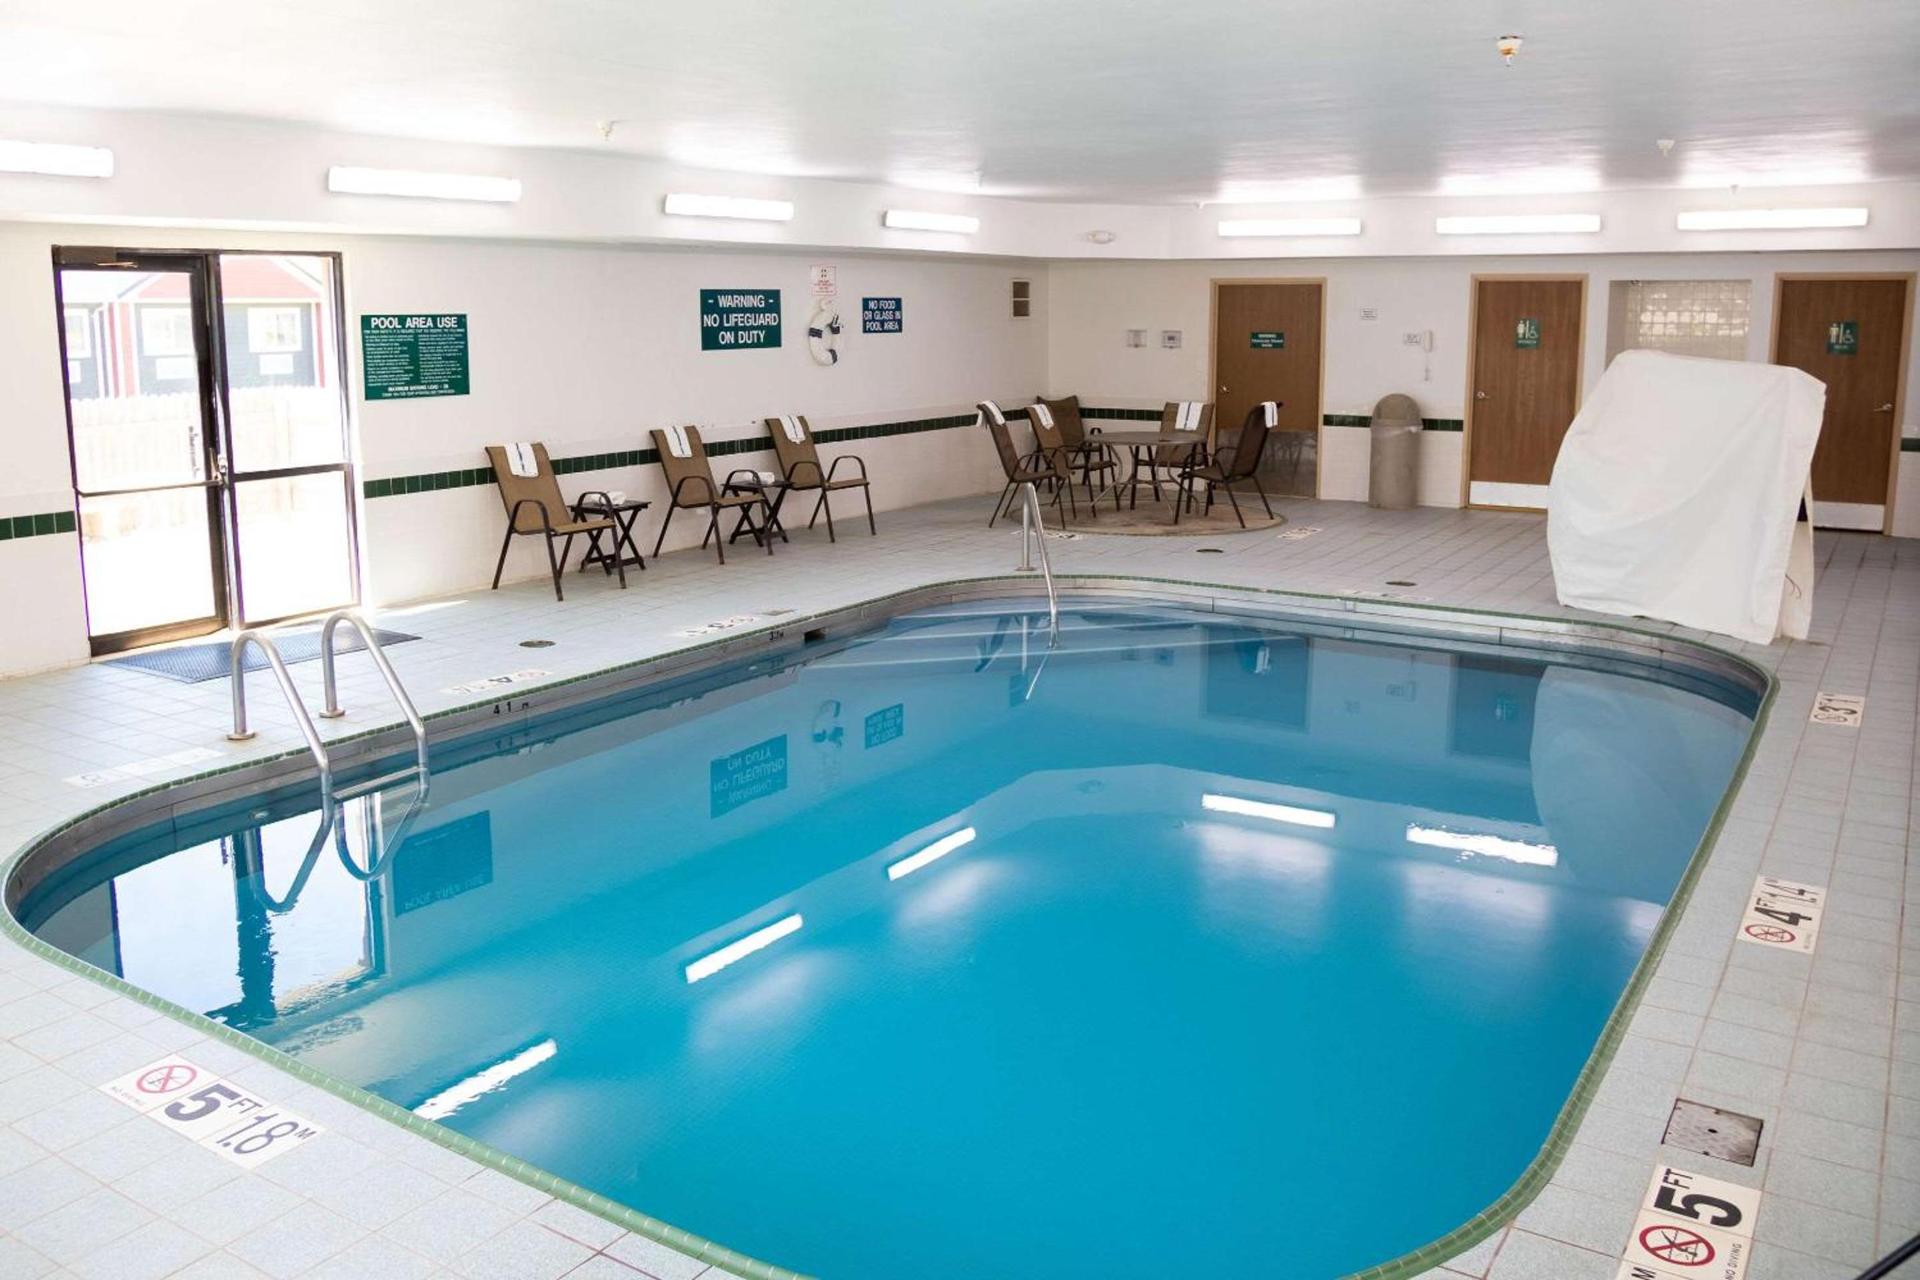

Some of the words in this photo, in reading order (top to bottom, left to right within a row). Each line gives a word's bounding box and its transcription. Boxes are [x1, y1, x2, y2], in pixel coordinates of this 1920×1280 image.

[717, 294, 765, 308] WARNING
[868, 300, 878, 310] NO
[879, 300, 896, 310] FOOD
[703, 313, 720, 327] NO
[723, 313, 779, 327] LIFEGUARD
[863, 311, 873, 320] OR
[874, 310, 894, 320] GLASS
[894, 311, 901, 320] IN
[370, 316, 402, 329] POOL
[405, 316, 434, 328] AREA
[436, 316, 458, 328] USE
[866, 321, 883, 331] POOL
[883, 321, 899, 331] AREA
[718, 331, 735, 345] ON
[738, 330, 766, 344] DUTY
[1817, 705, 1858, 715] 3
[1754, 906, 1813, 926] 4
[164, 1083, 243, 1122] 5
[228, 1097, 265, 1115] FT
[215, 1112, 300, 1155] 1.8
[294, 1127, 318, 1141] M
[1662, 1168, 1694, 1190] FT
[1653, 1185, 1743, 1228] 5
[1727, 1243, 1743, 1268] DIVING
[1631, 1266, 1657, 1280] M
